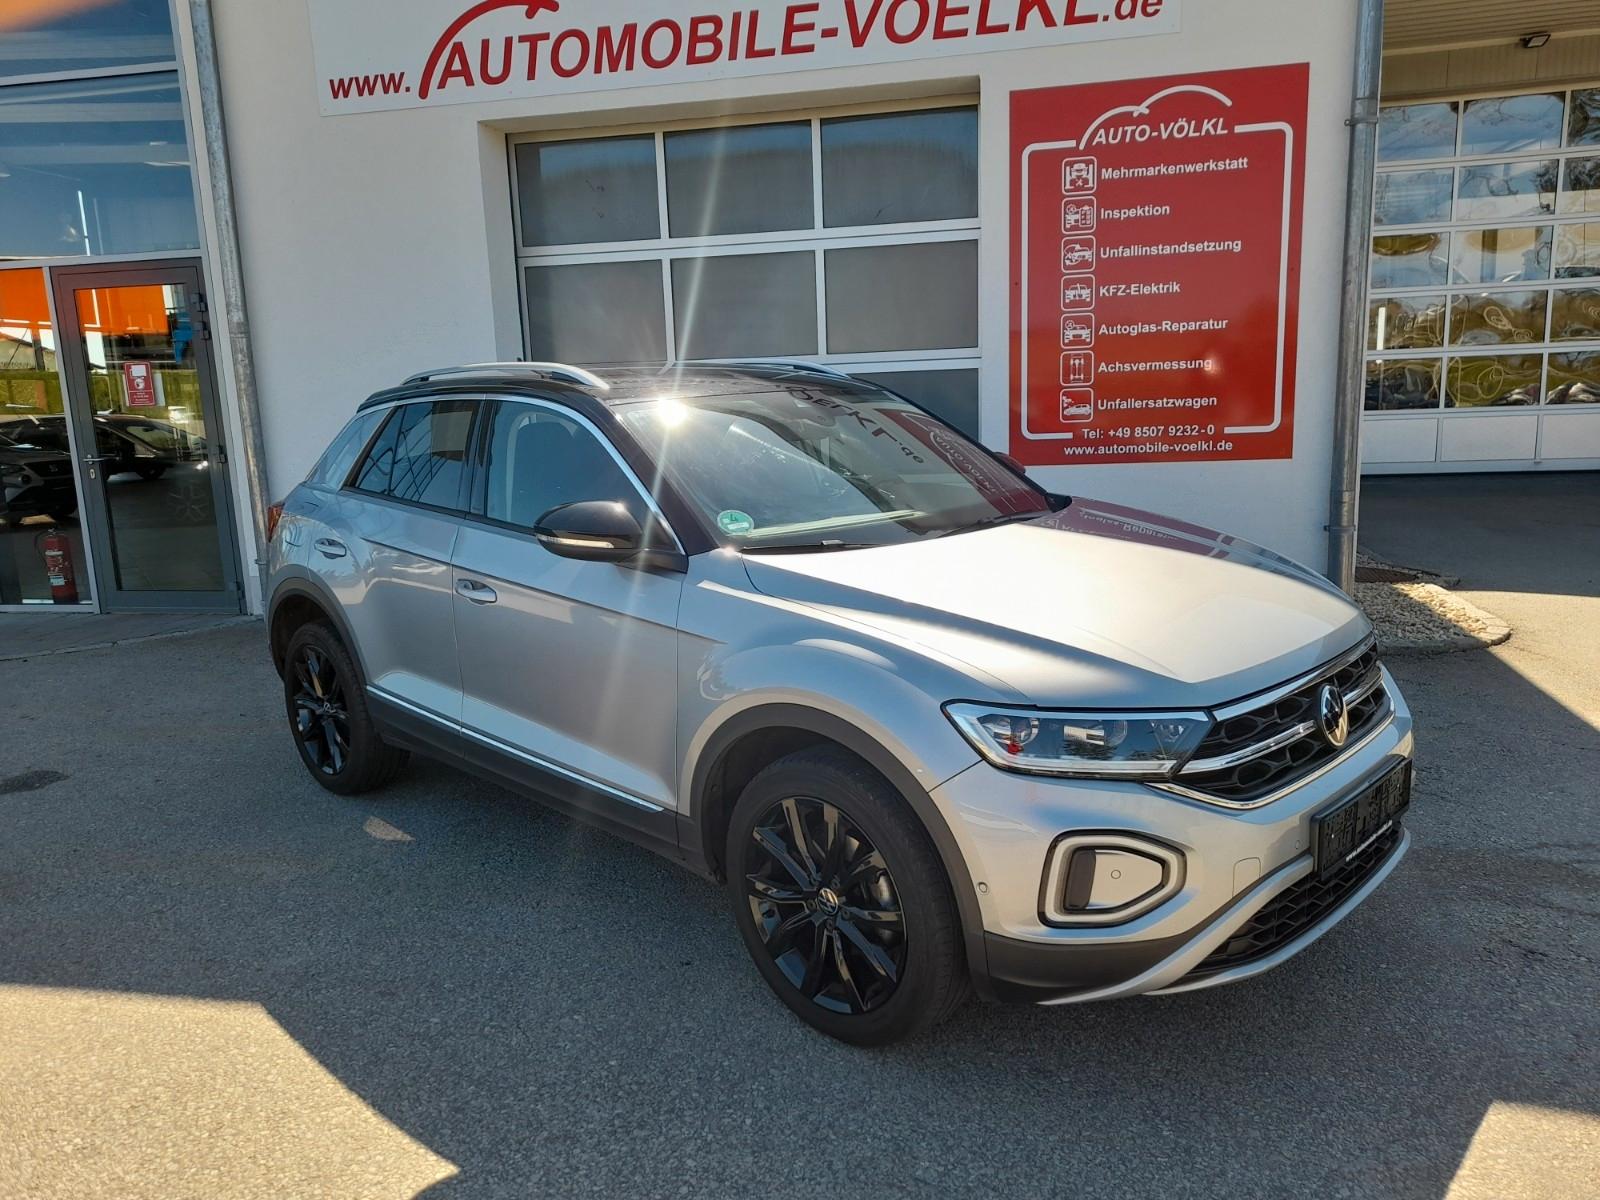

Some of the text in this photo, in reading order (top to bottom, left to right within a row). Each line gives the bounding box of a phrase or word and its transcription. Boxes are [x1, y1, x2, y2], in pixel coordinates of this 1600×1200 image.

[1092, 118, 1229, 146] AUTO-VÖLKL
[1101, 157, 1249, 180] Mehrmarkenwerkstatt
[1100, 205, 1170, 220] Inspektion
[1100, 240, 1242, 258] Unfallinstandsetzung
[1099, 282, 1181, 297] KFZ-Elektrik
[1098, 319, 1229, 336] Autoglas-Reparatur
[1098, 358, 1213, 373] Achsvermessung
[1098, 395, 1218, 410] Unfallersatzwagen
[1082, 428, 1104, 439] Tel:
[1108, 427, 1131, 439] +49
[1134, 426, 1163, 438] 8507
[1064, 440, 1234, 456] www.automobile-voelkl.de
